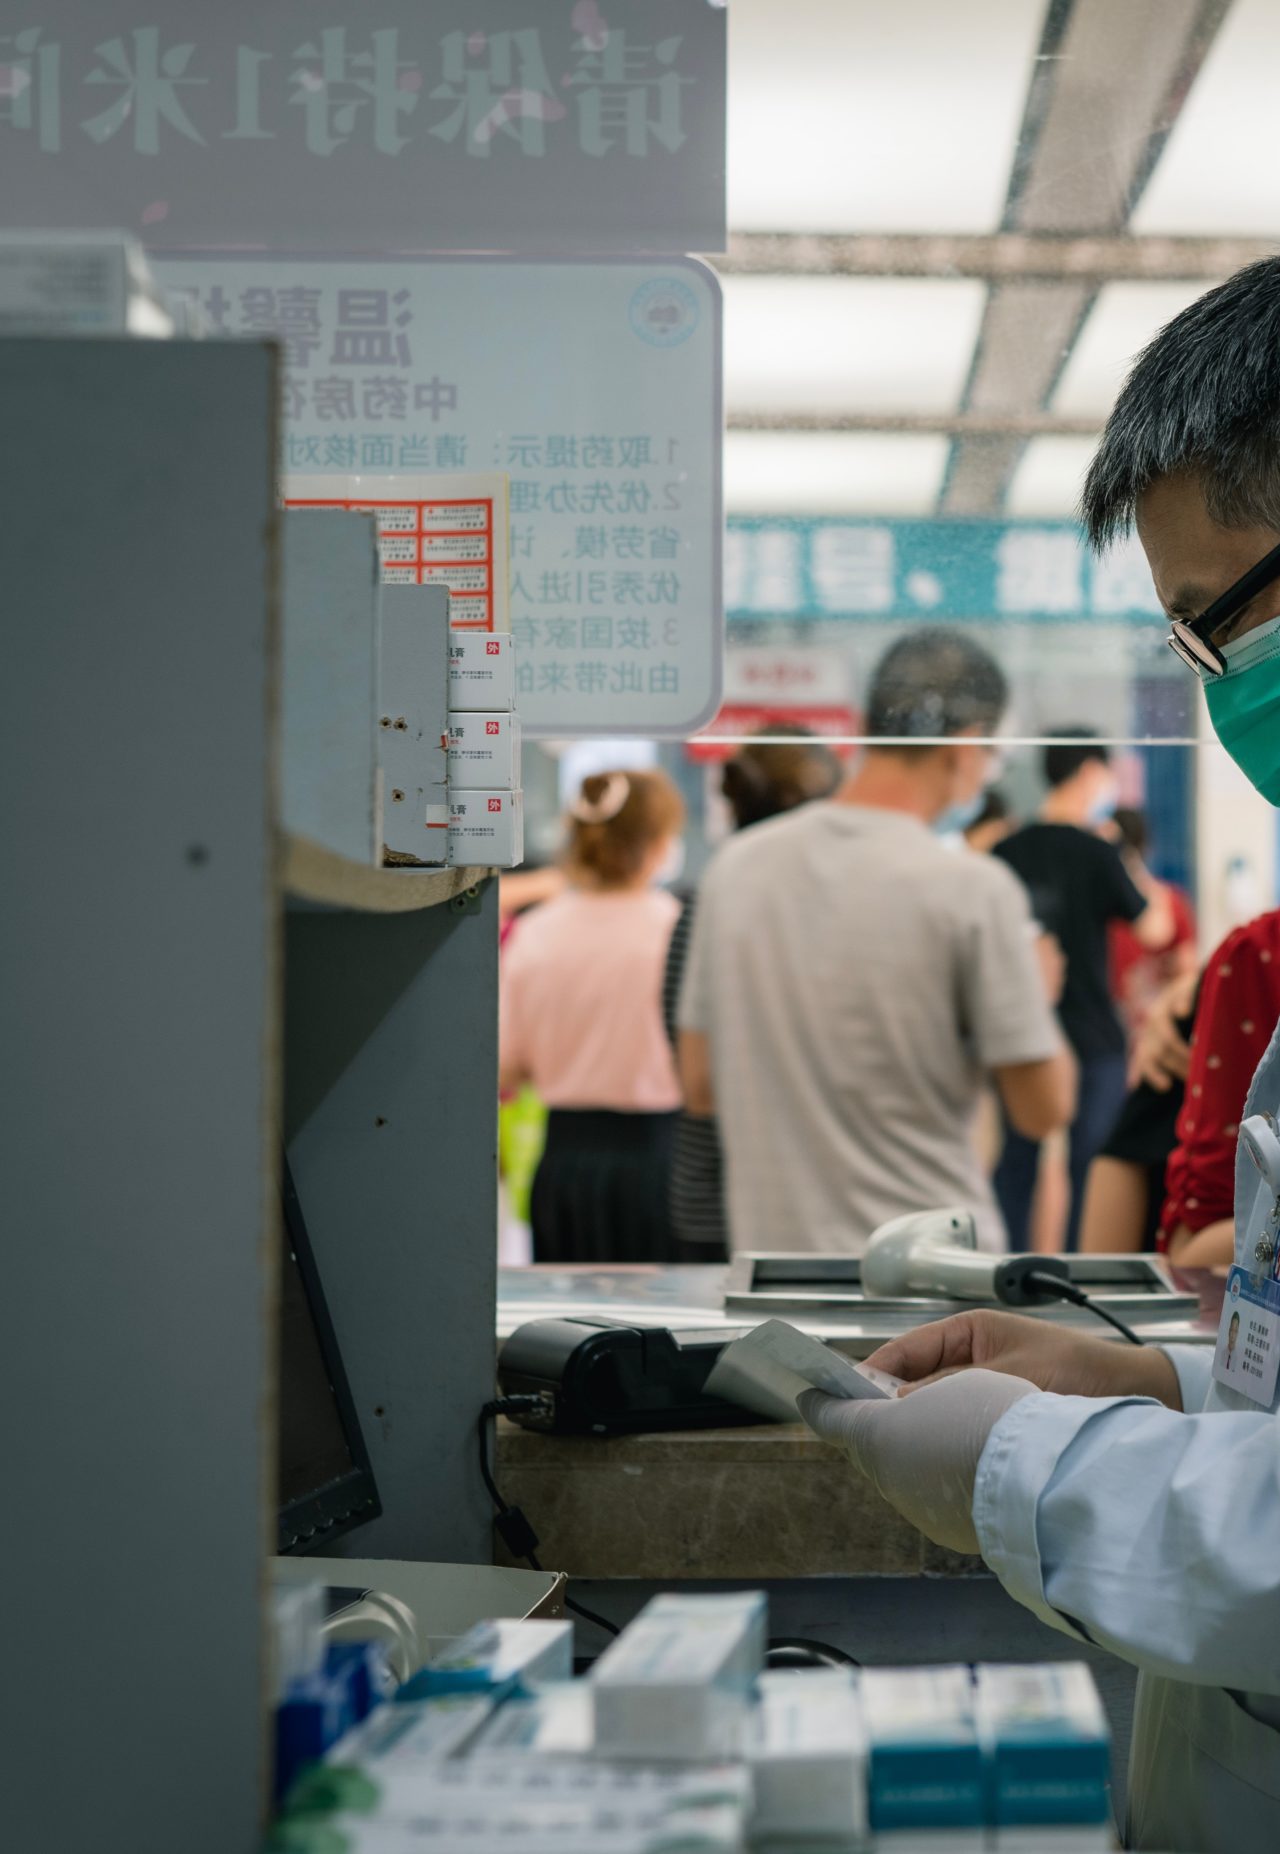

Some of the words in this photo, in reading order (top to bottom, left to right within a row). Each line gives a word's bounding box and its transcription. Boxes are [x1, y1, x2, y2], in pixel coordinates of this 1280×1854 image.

[487, 642, 499, 655] 外
[486, 721, 499, 734] 外
[488, 799, 501, 811] 外
